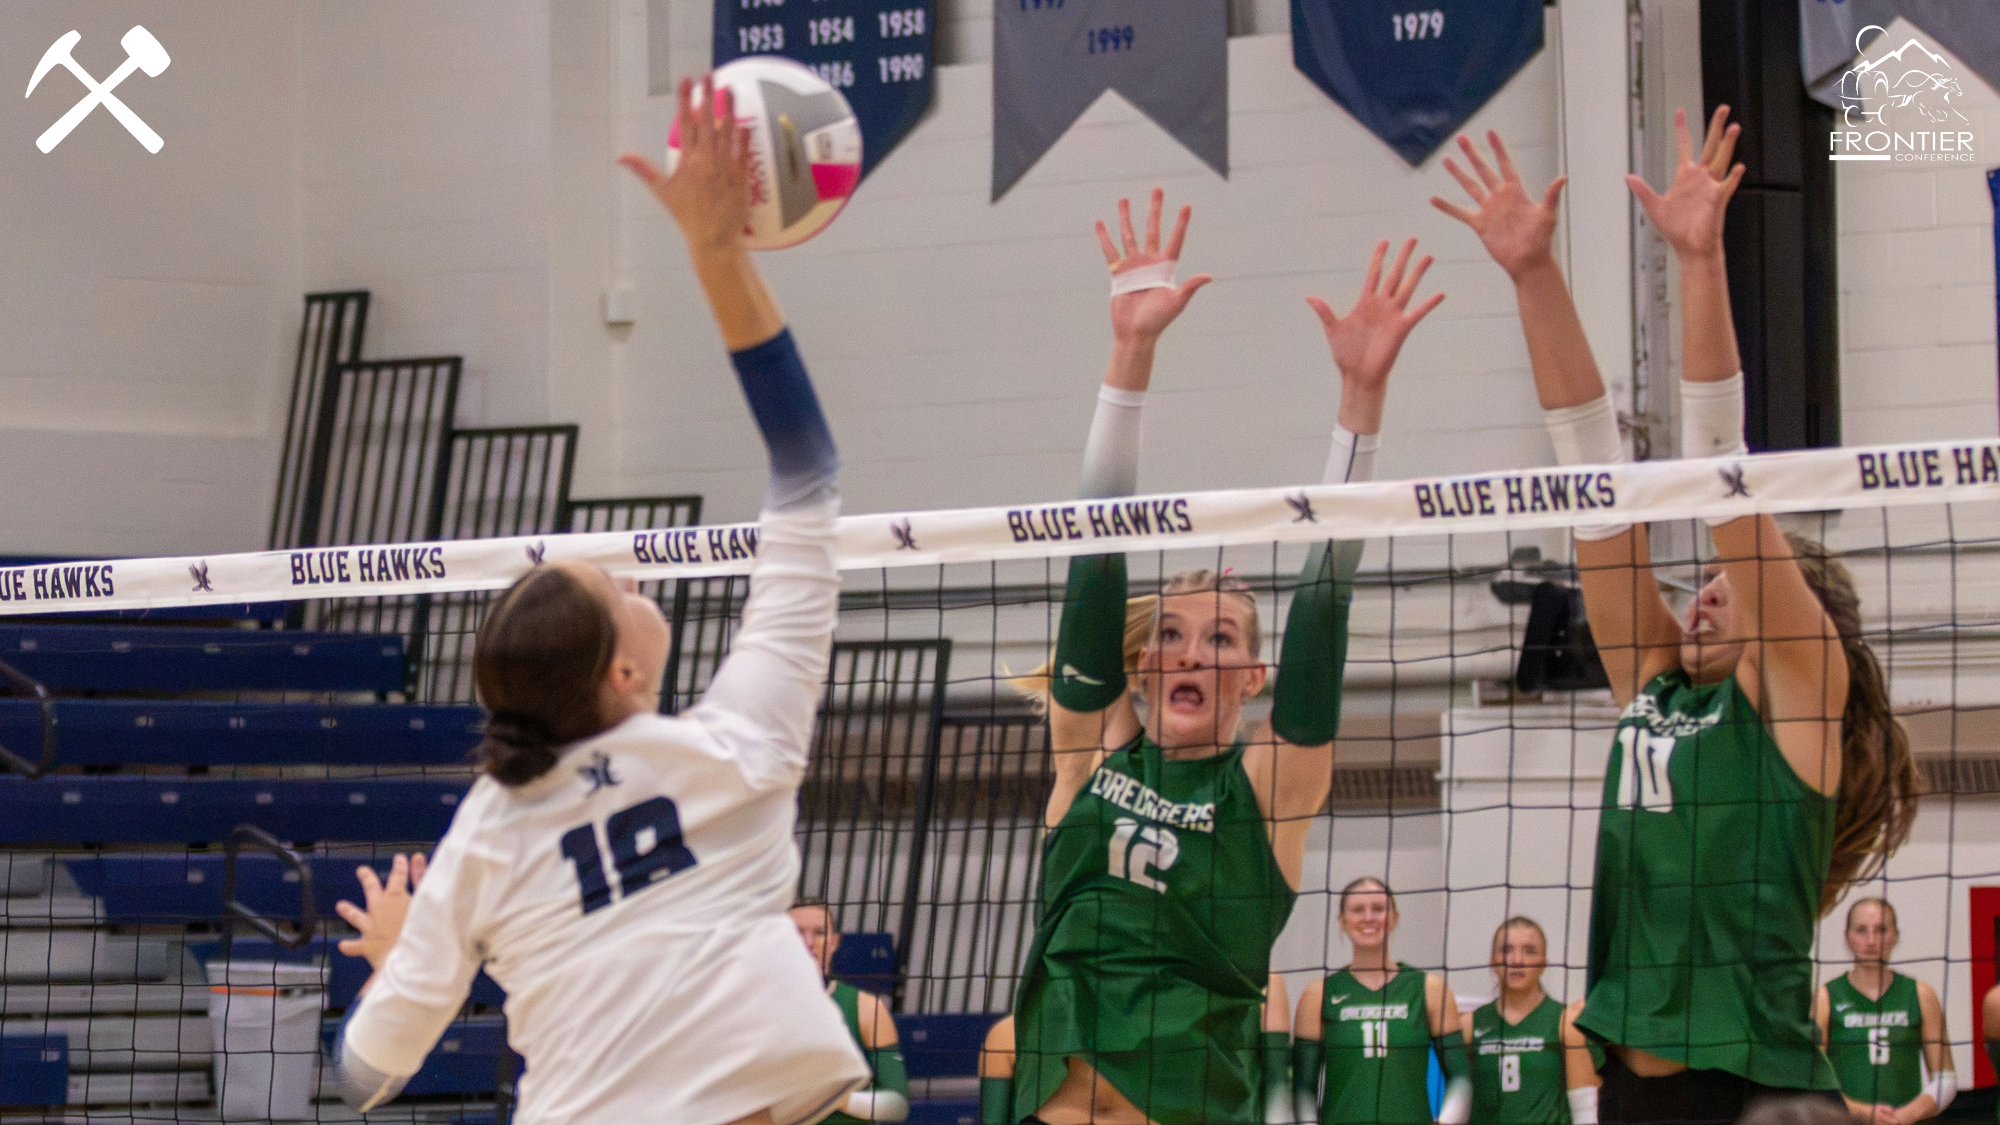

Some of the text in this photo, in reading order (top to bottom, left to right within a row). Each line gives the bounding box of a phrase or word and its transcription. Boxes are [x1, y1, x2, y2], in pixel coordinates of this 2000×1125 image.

[738, 8, 926, 52] 1953 1954 1958
[1088, 25, 1134, 54] 1999
[1392, 10, 1444, 41] 1979
[878, 53, 924, 83] 1990
[1858, 446, 2000, 489] BLUE HA
[1415, 473, 1615, 517] BLUE HAWKS
[1008, 499, 1191, 541] BLUE HAWKS
[634, 527, 759, 563] BLUE HAW
[33, 565, 114, 599] HAWKS
[291, 547, 446, 585] BLUE HAWKS
[1617, 725, 1676, 813] 10
[561, 796, 697, 914] 18
[1108, 817, 1179, 895] 12
[1362, 1021, 1388, 1058] 11
[1868, 1027, 1890, 1065] 6
[1499, 1054, 1521, 1092] 8
